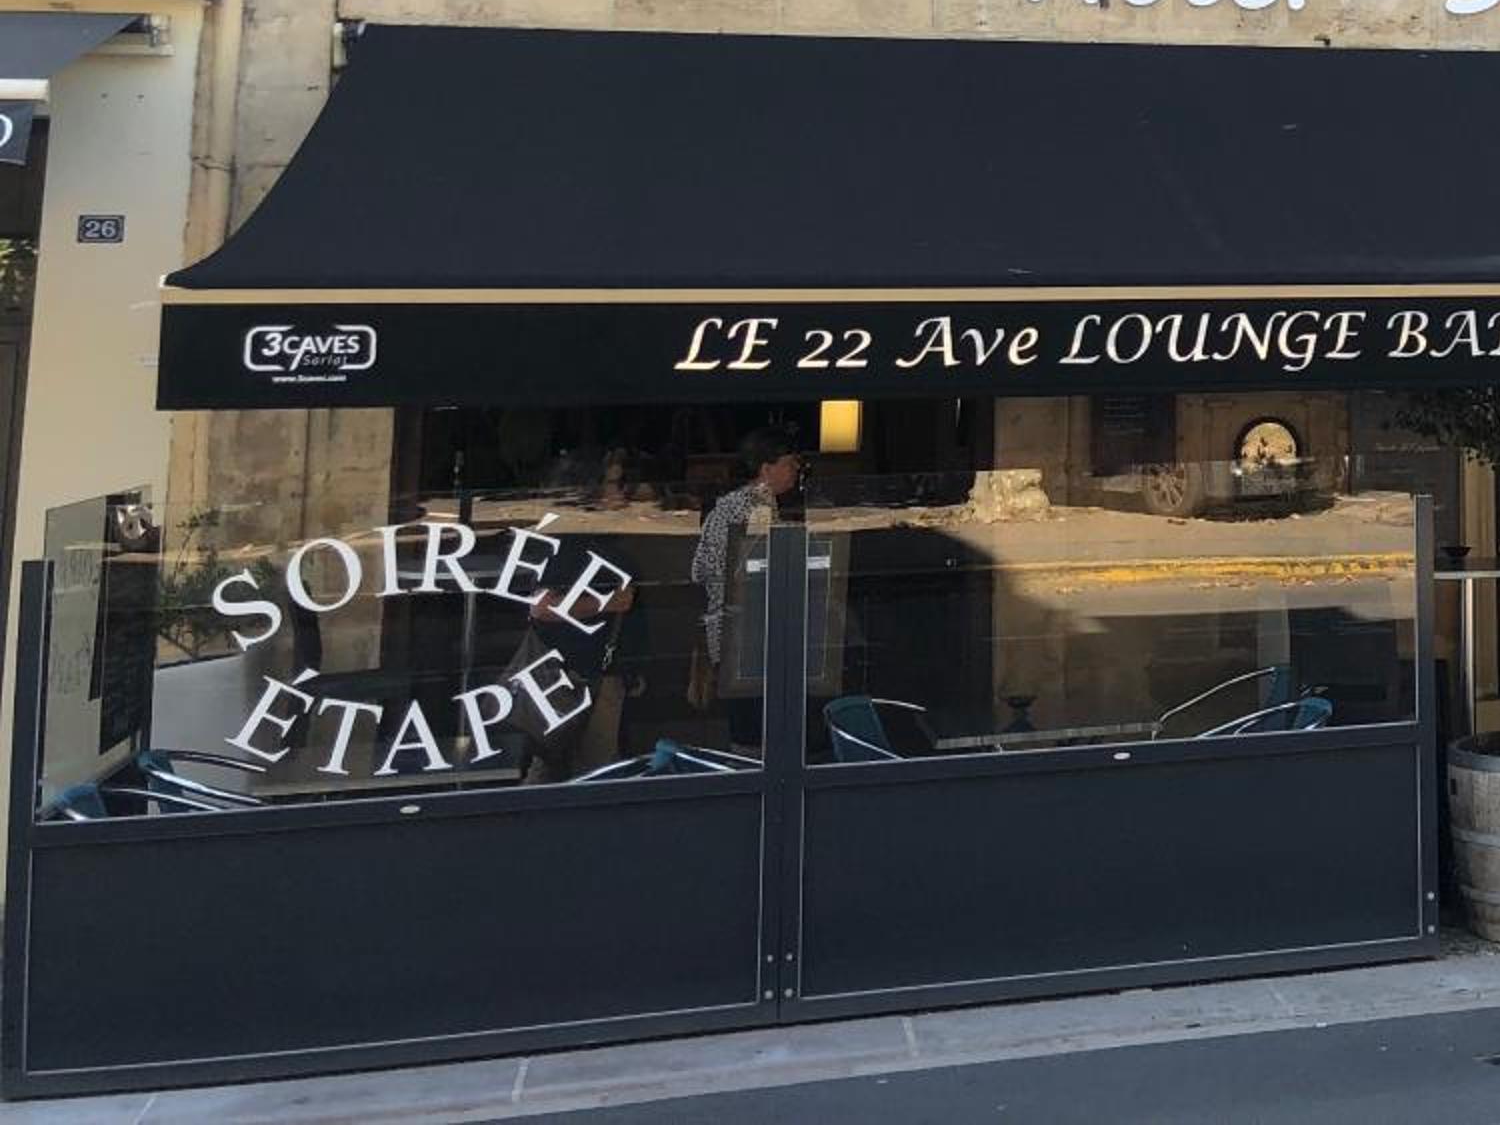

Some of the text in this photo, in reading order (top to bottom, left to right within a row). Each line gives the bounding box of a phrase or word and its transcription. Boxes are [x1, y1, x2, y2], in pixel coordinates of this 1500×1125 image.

[85, 220, 117, 238] 26
[675, 317, 779, 372] LE
[797, 328, 870, 370] 22
[895, 315, 1039, 367] Ave
[1059, 311, 1367, 371] LOUNGE
[212, 513, 633, 652] SOIRÉE
[225, 649, 592, 775] ÉTAPE
